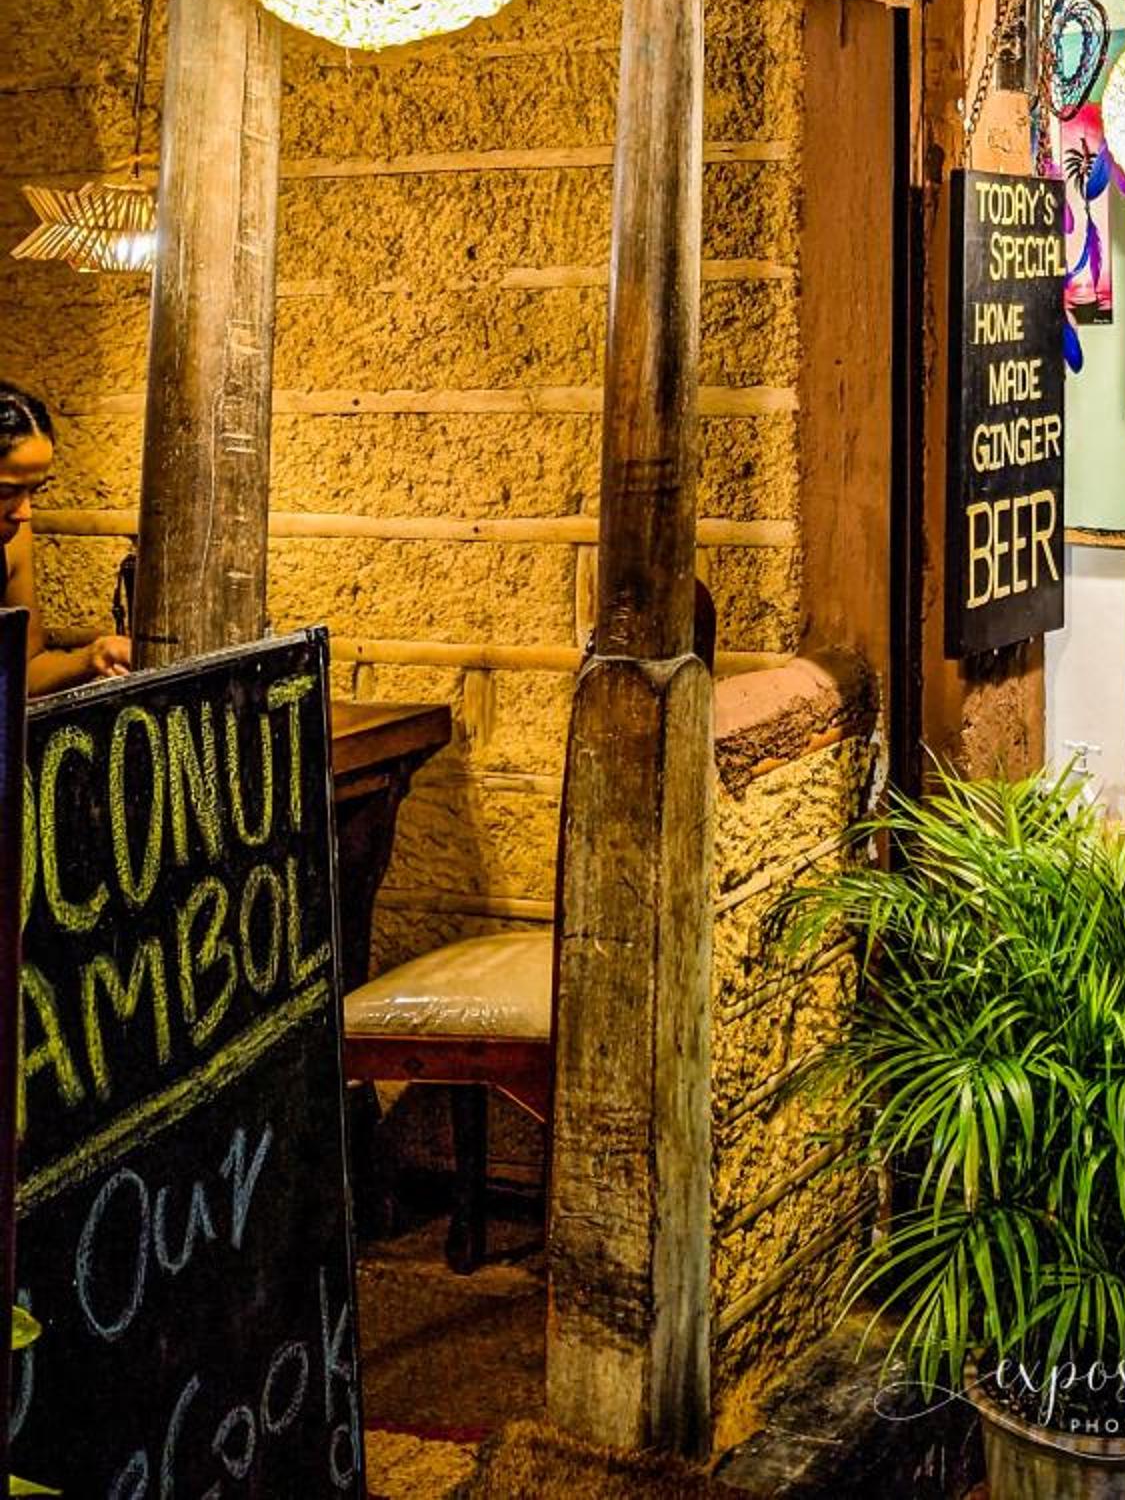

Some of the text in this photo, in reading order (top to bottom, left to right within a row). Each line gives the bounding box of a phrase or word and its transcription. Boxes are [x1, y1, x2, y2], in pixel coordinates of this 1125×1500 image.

[989, 232, 1066, 281] SPECIAL
[974, 303, 1024, 347] HOME
[989, 358, 1042, 406] MADE
[972, 415, 1062, 474] GINGER
[965, 488, 1060, 610] BEER
[24, 675, 316, 933] CONUT
